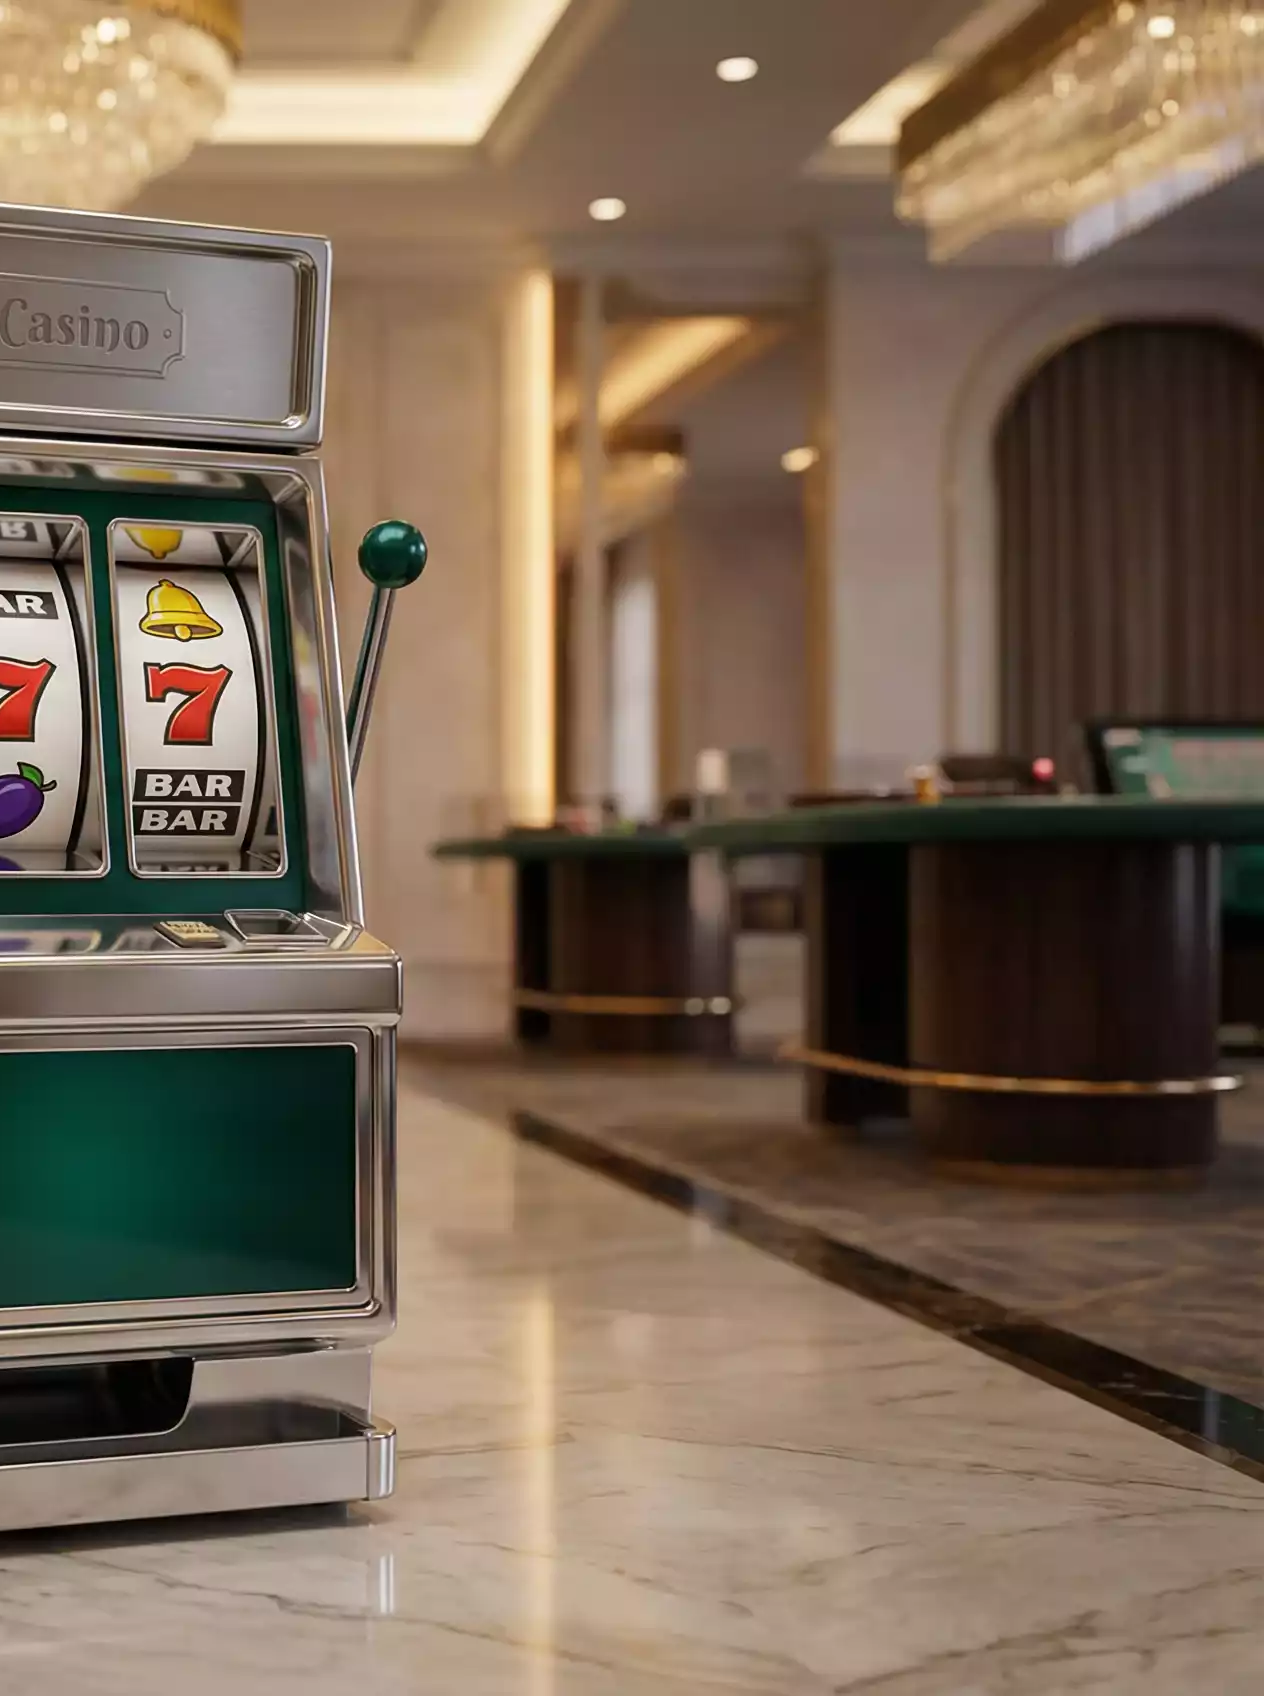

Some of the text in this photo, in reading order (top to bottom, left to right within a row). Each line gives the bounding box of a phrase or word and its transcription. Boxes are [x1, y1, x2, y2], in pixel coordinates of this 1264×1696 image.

[143, 662, 233, 746] 7
[144, 773, 232, 797] BAR
[139, 809, 228, 831] BAR
